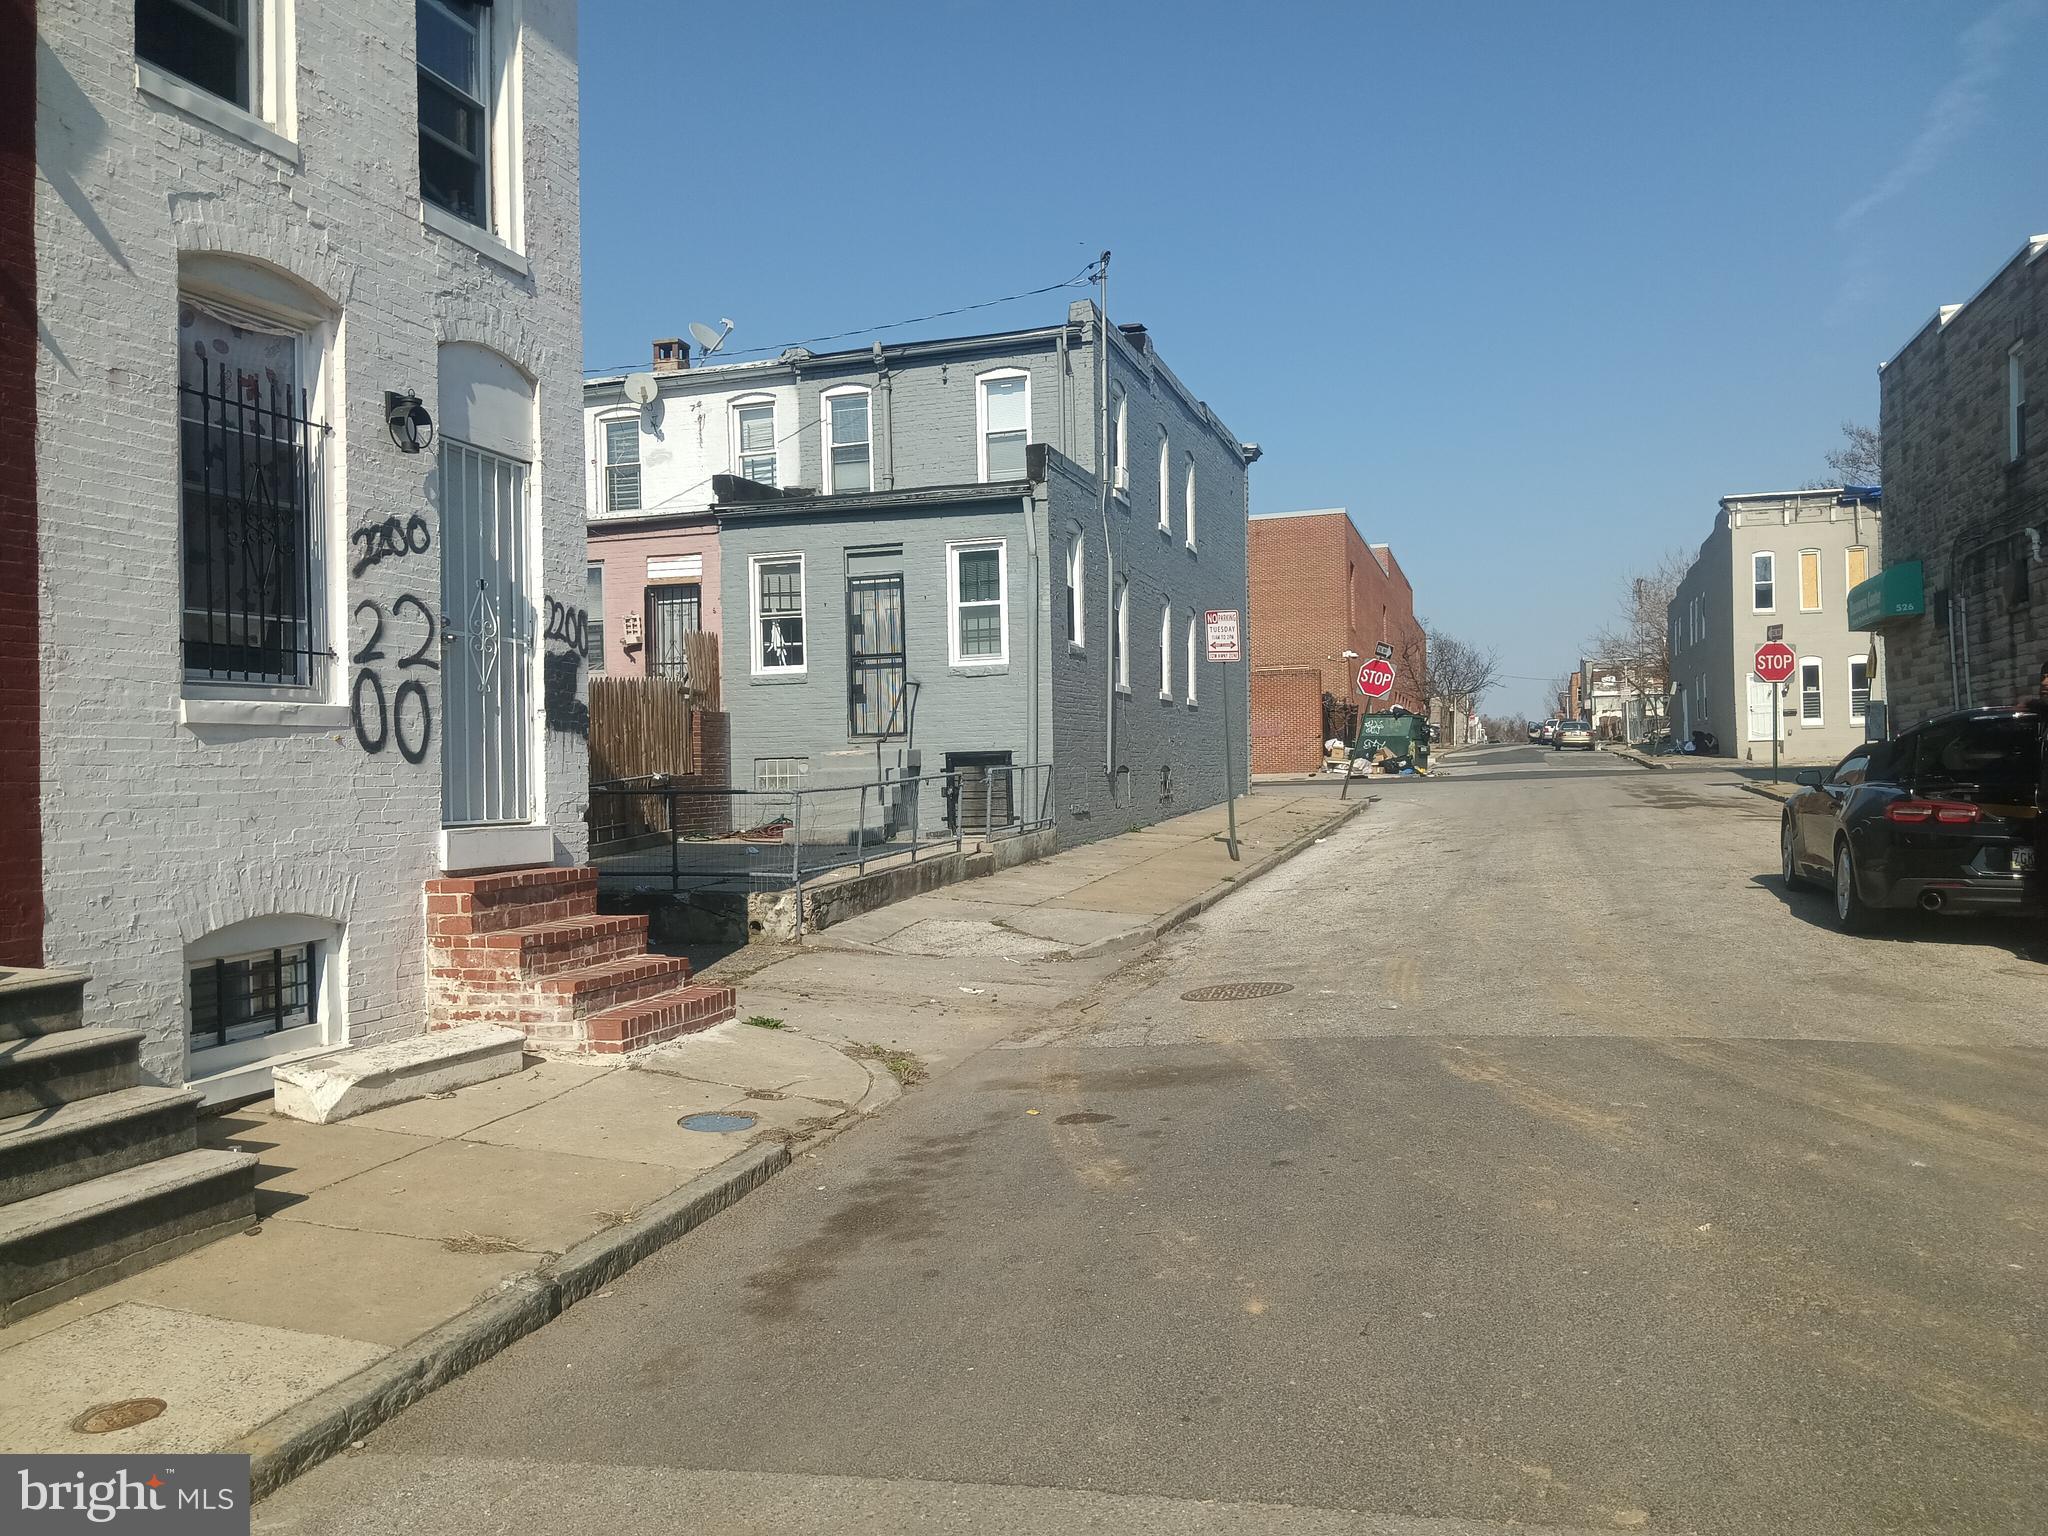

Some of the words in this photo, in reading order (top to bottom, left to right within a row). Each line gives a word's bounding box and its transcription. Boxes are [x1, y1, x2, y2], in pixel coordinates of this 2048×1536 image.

[1896, 603, 1914, 611] 526
[544, 594, 589, 657] 2200
[1207, 613, 1218, 624] NO
[354, 594, 439, 670] 22
[1757, 655, 1792, 669] STOP
[1361, 669, 1391, 686] STOP
[352, 668, 431, 764] 00
